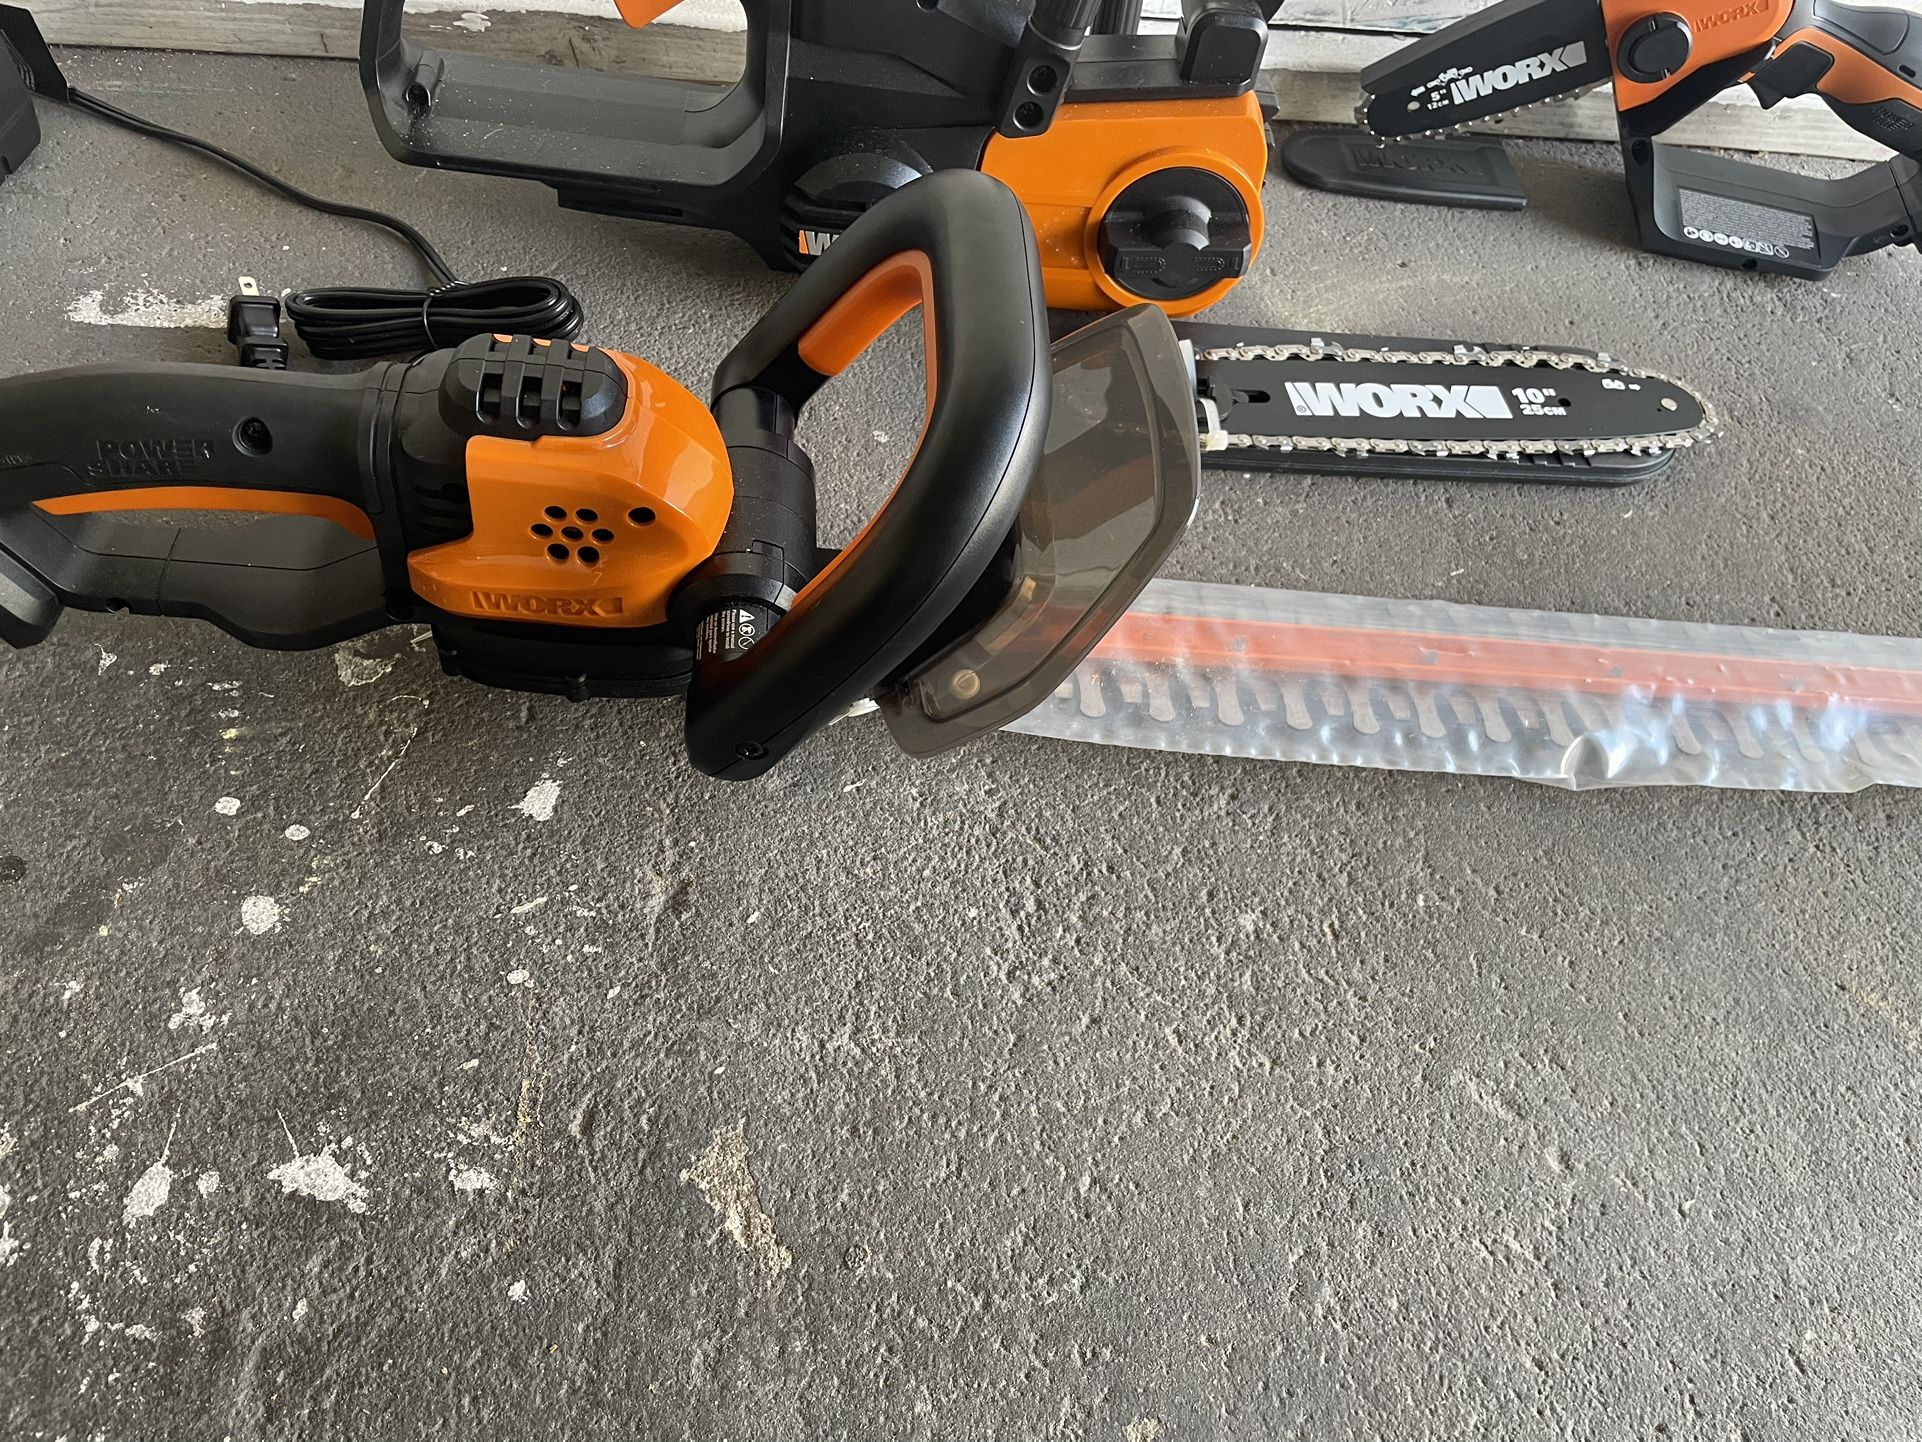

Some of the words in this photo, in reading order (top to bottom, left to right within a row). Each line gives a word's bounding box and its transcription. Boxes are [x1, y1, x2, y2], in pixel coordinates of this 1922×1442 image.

[1454, 46, 1569, 102] WORX
[1292, 382, 1485, 418] WORX
[1511, 387, 1556, 404] 10"
[96, 439, 214, 460] POWER
[477, 591, 604, 617] WORX
